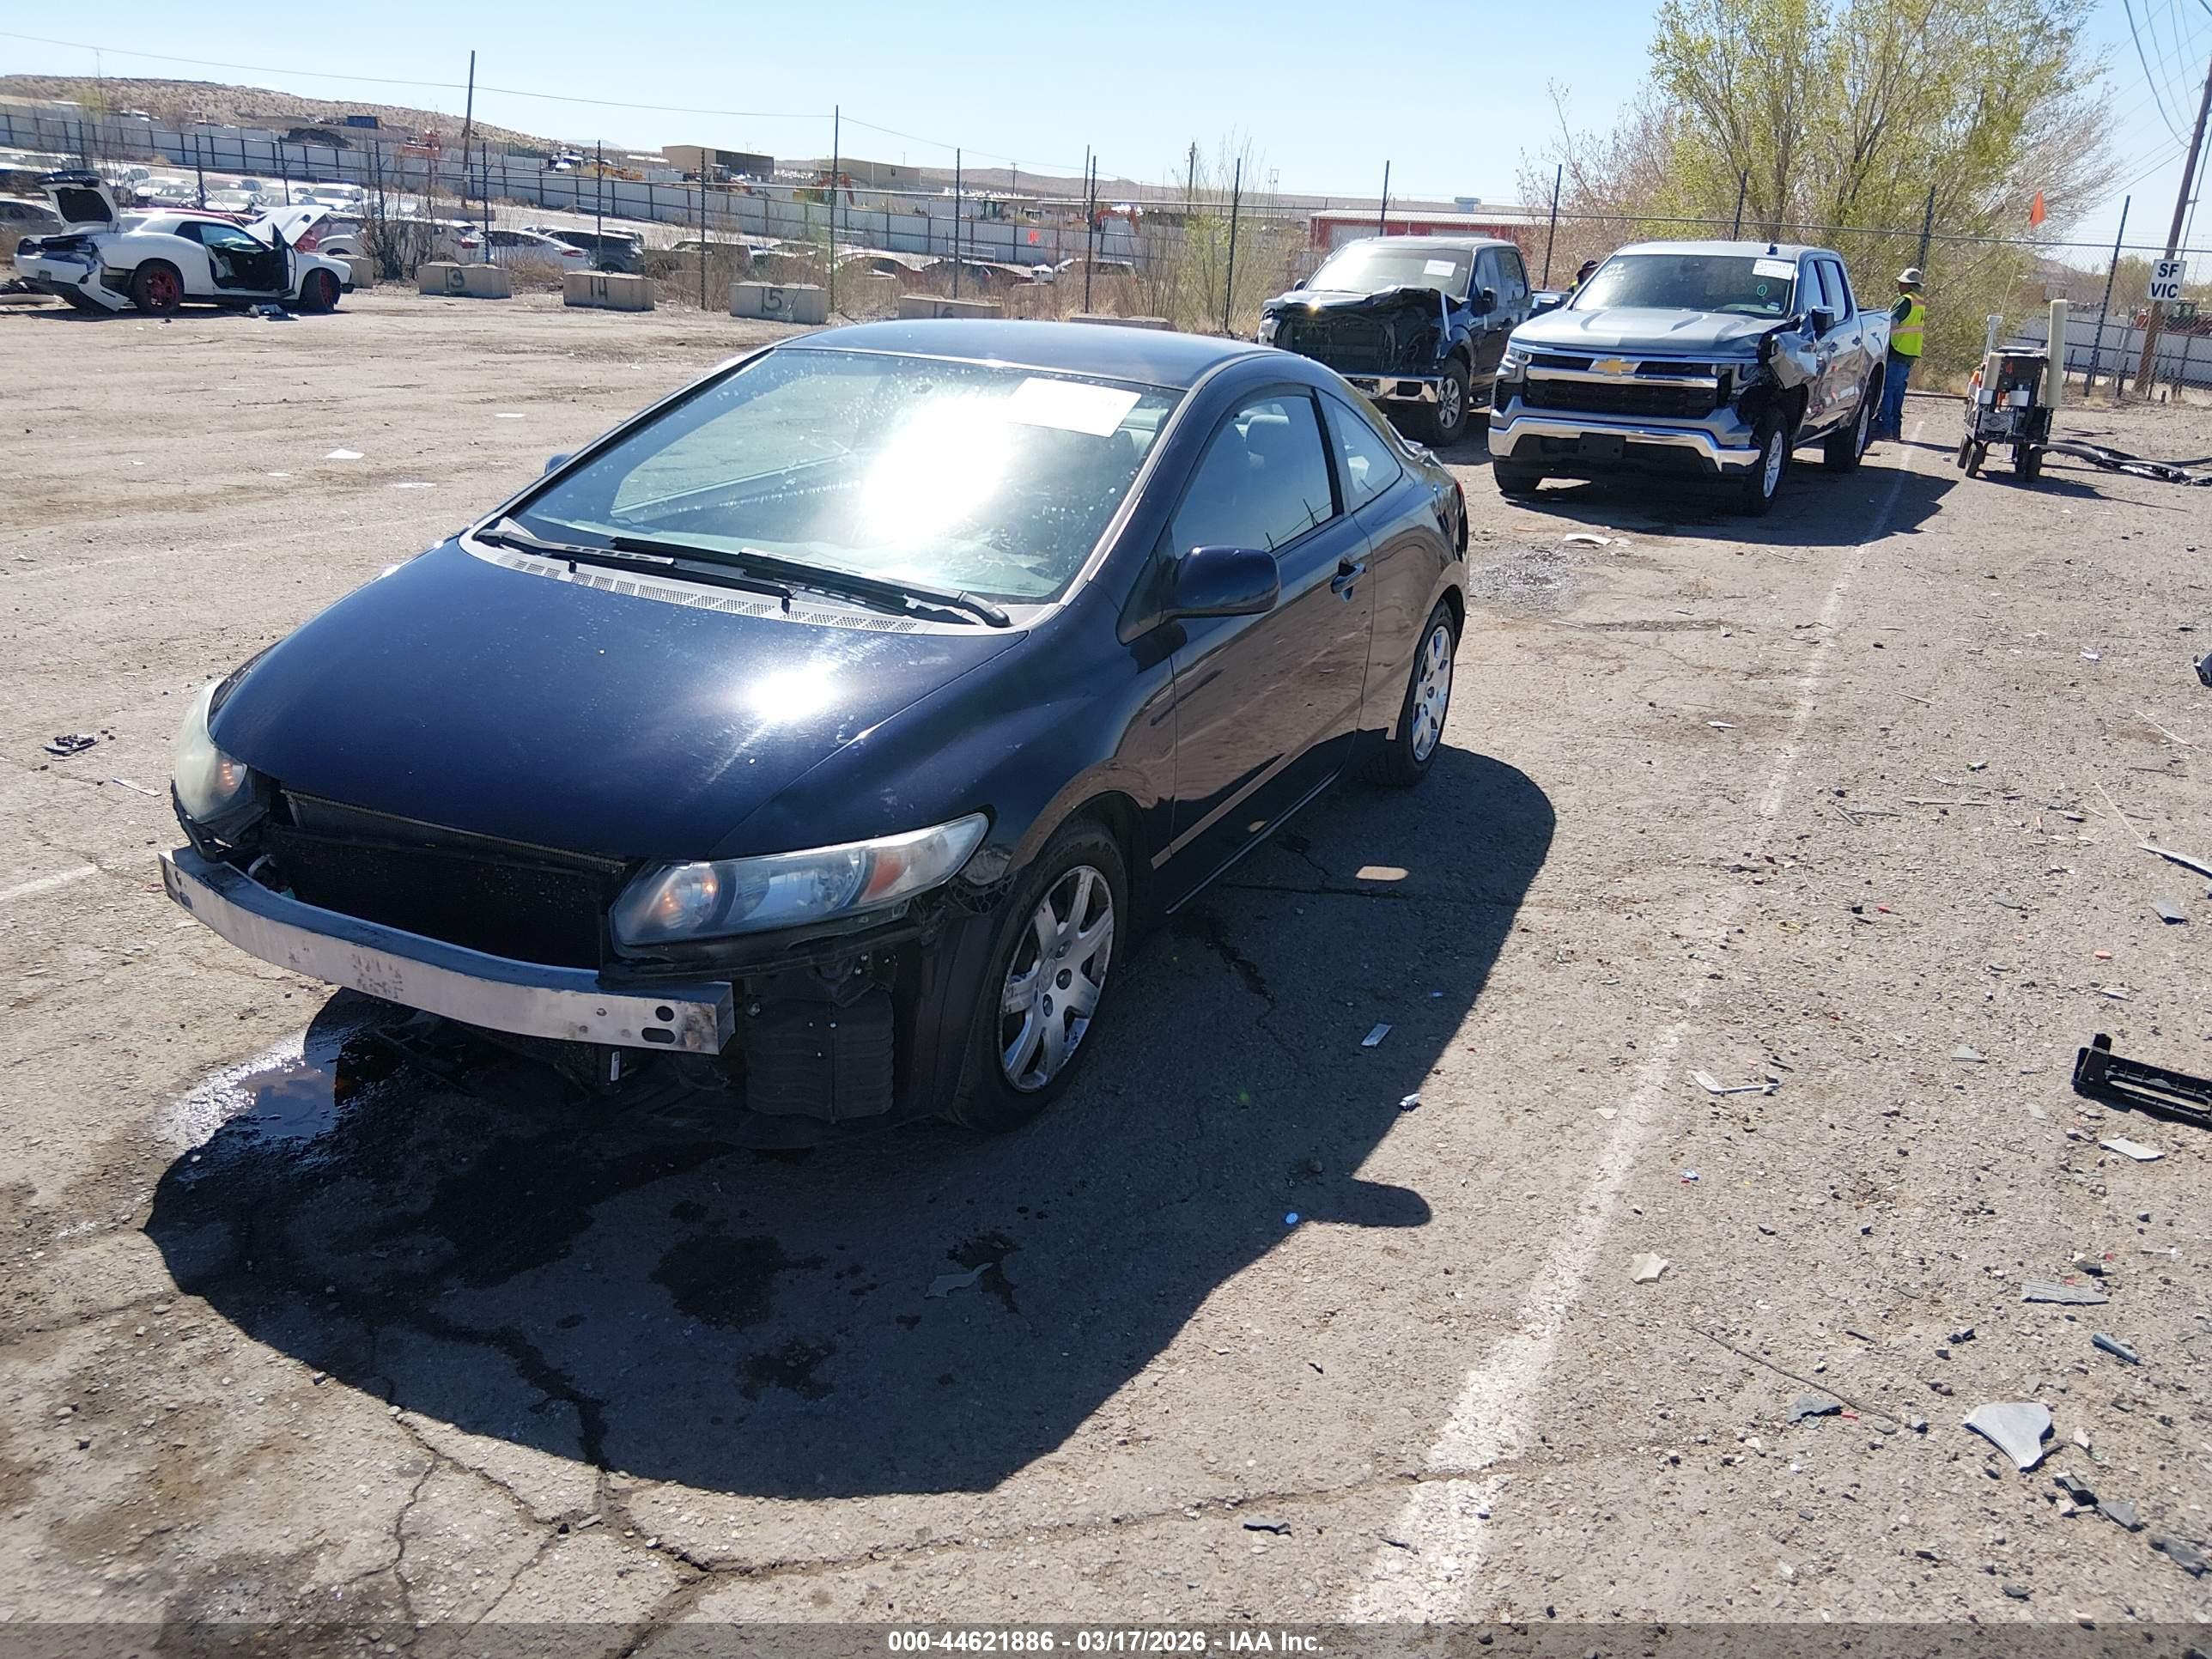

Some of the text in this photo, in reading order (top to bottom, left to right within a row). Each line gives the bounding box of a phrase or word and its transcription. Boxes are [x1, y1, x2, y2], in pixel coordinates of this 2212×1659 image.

[445, 267, 465, 291] 13
[2158, 263, 2179, 278] SF
[590, 275, 608, 301] 14
[761, 287, 783, 313] 15
[2151, 283, 2179, 298] VIC
